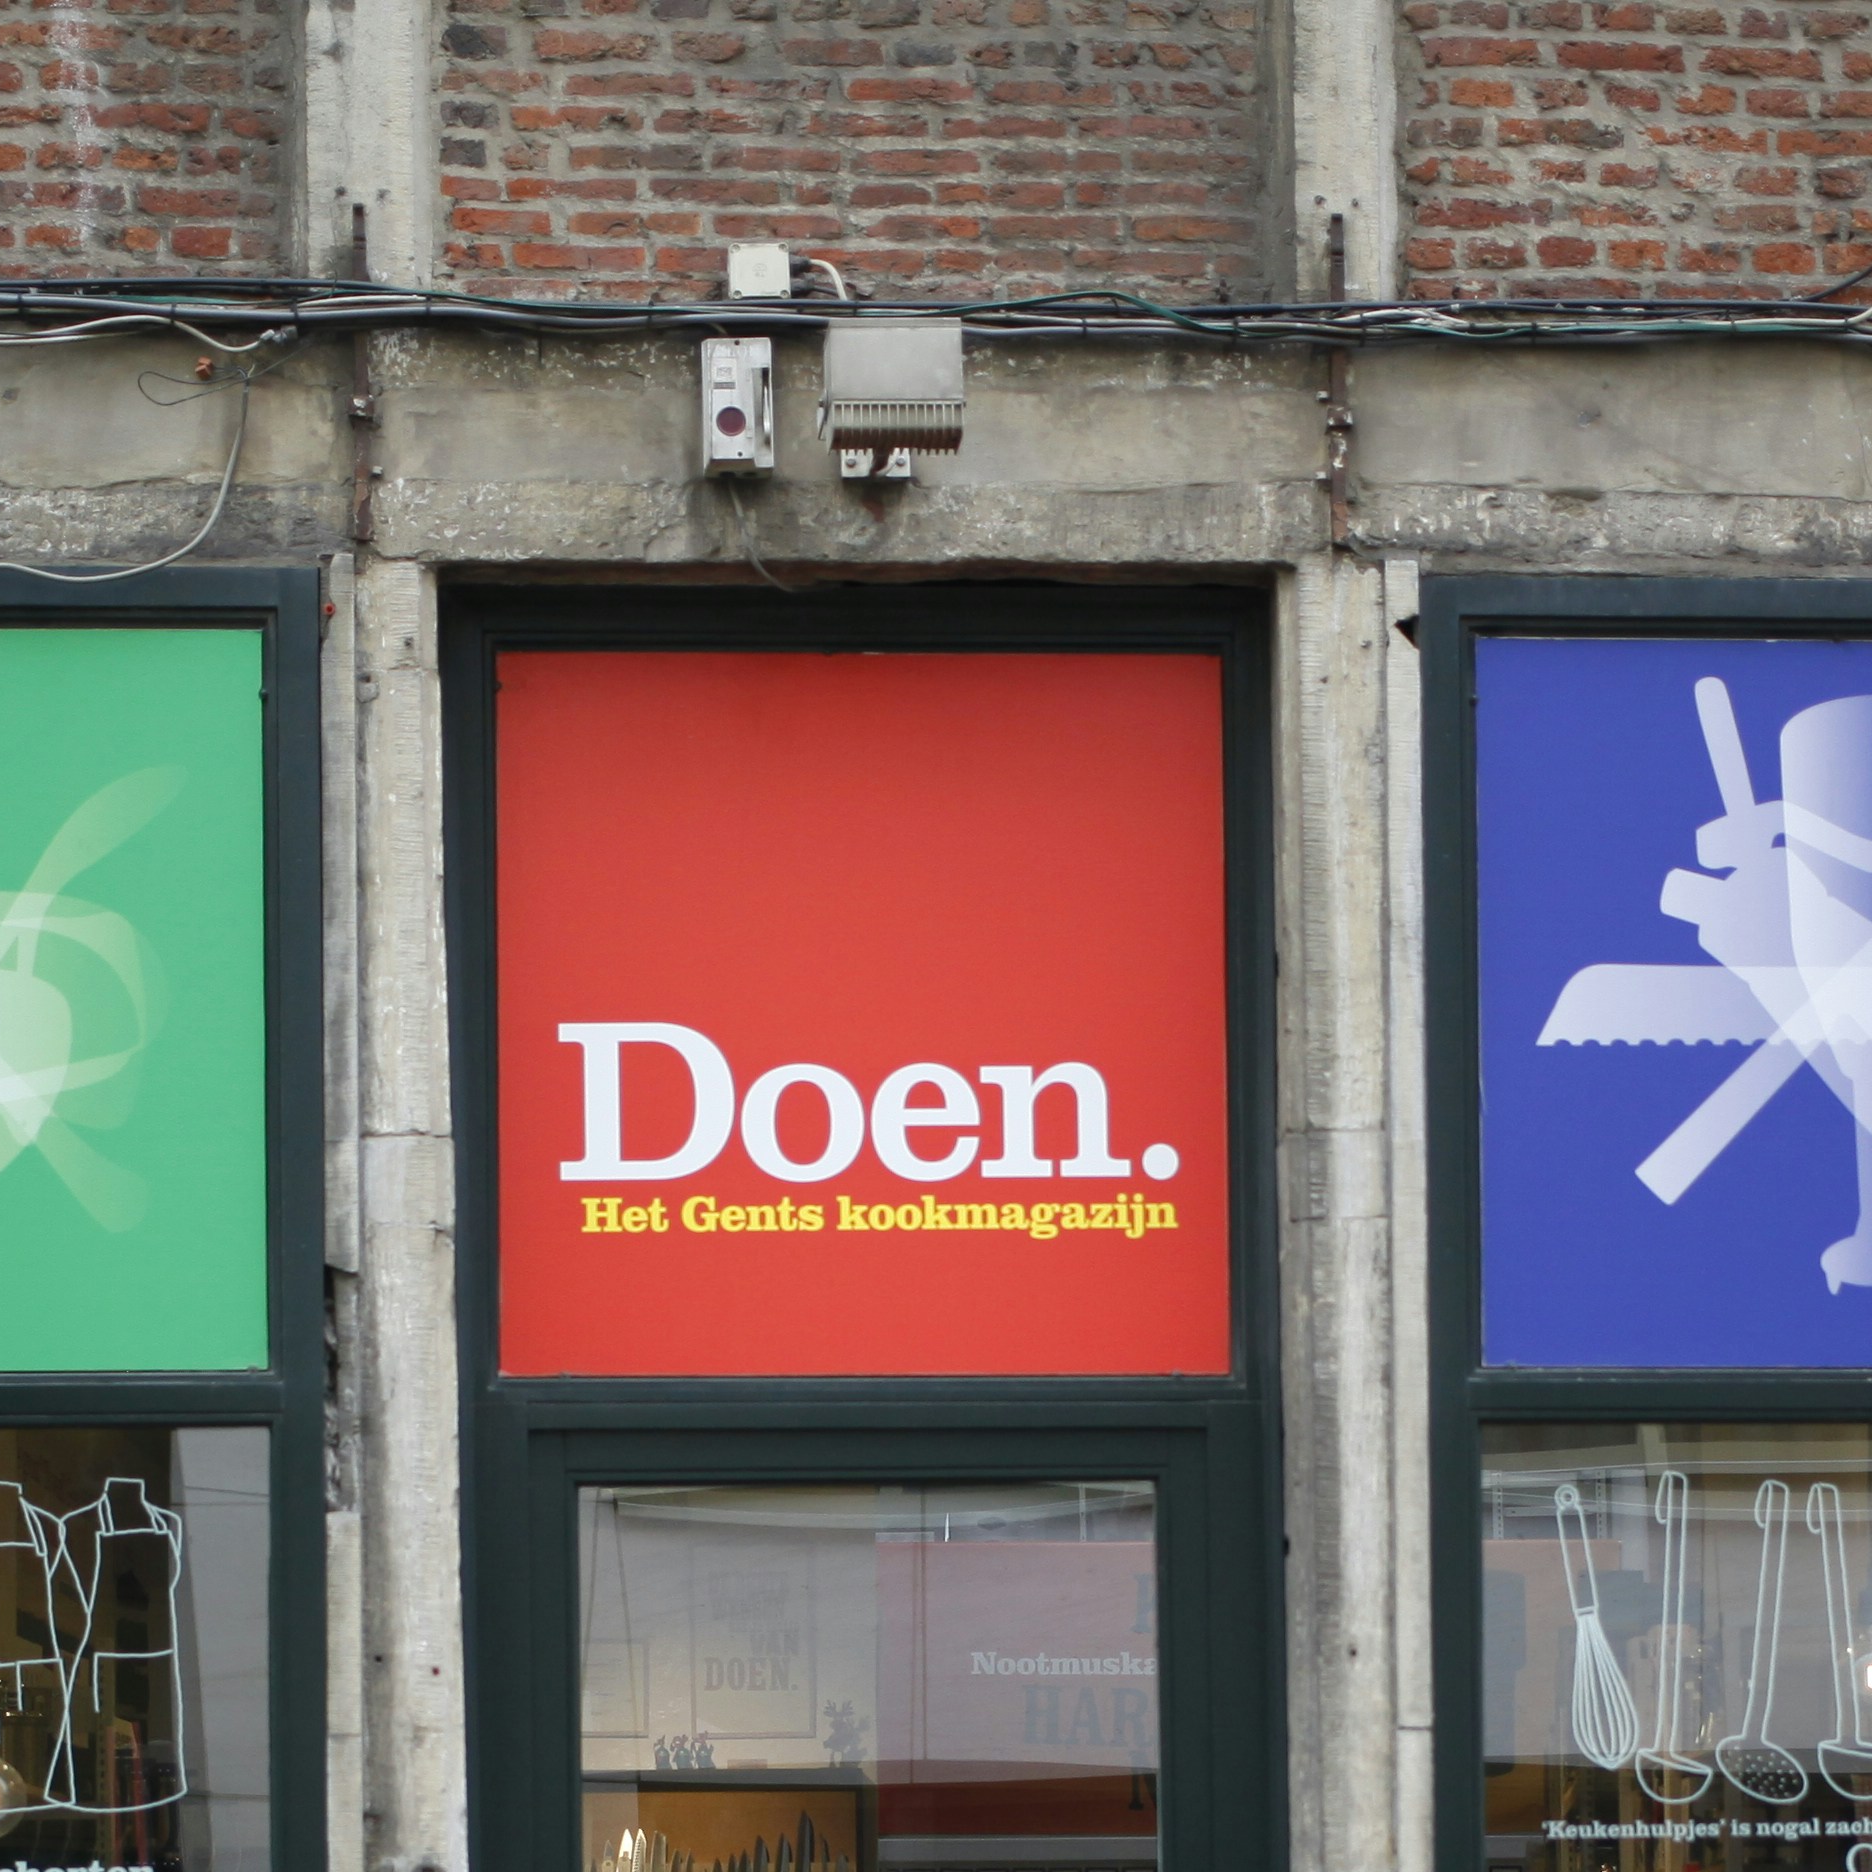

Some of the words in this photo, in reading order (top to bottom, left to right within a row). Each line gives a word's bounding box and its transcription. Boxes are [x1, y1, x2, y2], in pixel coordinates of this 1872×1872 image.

[558, 1022, 1179, 1182] Doen.
[581, 1197, 669, 1232] Het
[681, 1196, 825, 1231] Gents
[837, 1193, 1179, 1239] kookmagazijn
[703, 1657, 798, 1691] DOEN.
[1731, 1819, 1750, 1836] is
[1756, 1818, 1820, 1840] nogal
